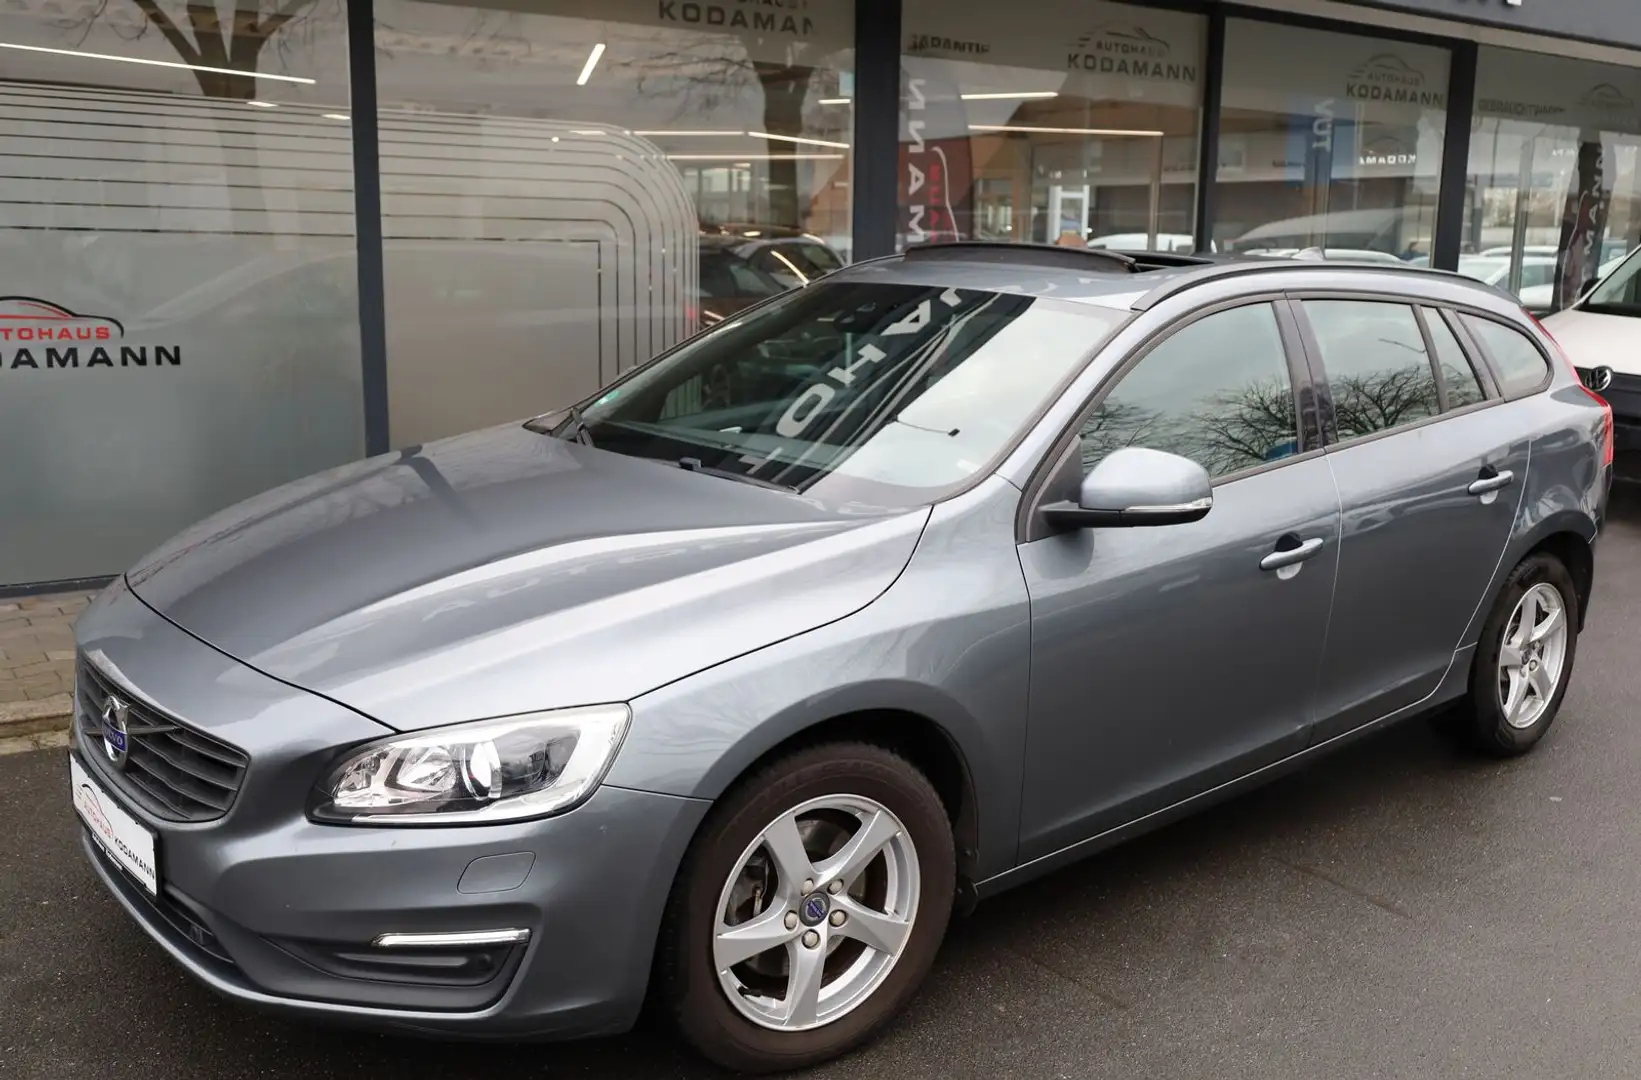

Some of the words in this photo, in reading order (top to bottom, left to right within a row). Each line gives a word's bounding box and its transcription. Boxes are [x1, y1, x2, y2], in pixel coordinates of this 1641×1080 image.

[1067, 53, 1196, 82] KODAMANN
[1346, 83, 1444, 107] KODAMANN
[0, 345, 181, 369] AMANN
[114, 837, 155, 880] KODAMANN
